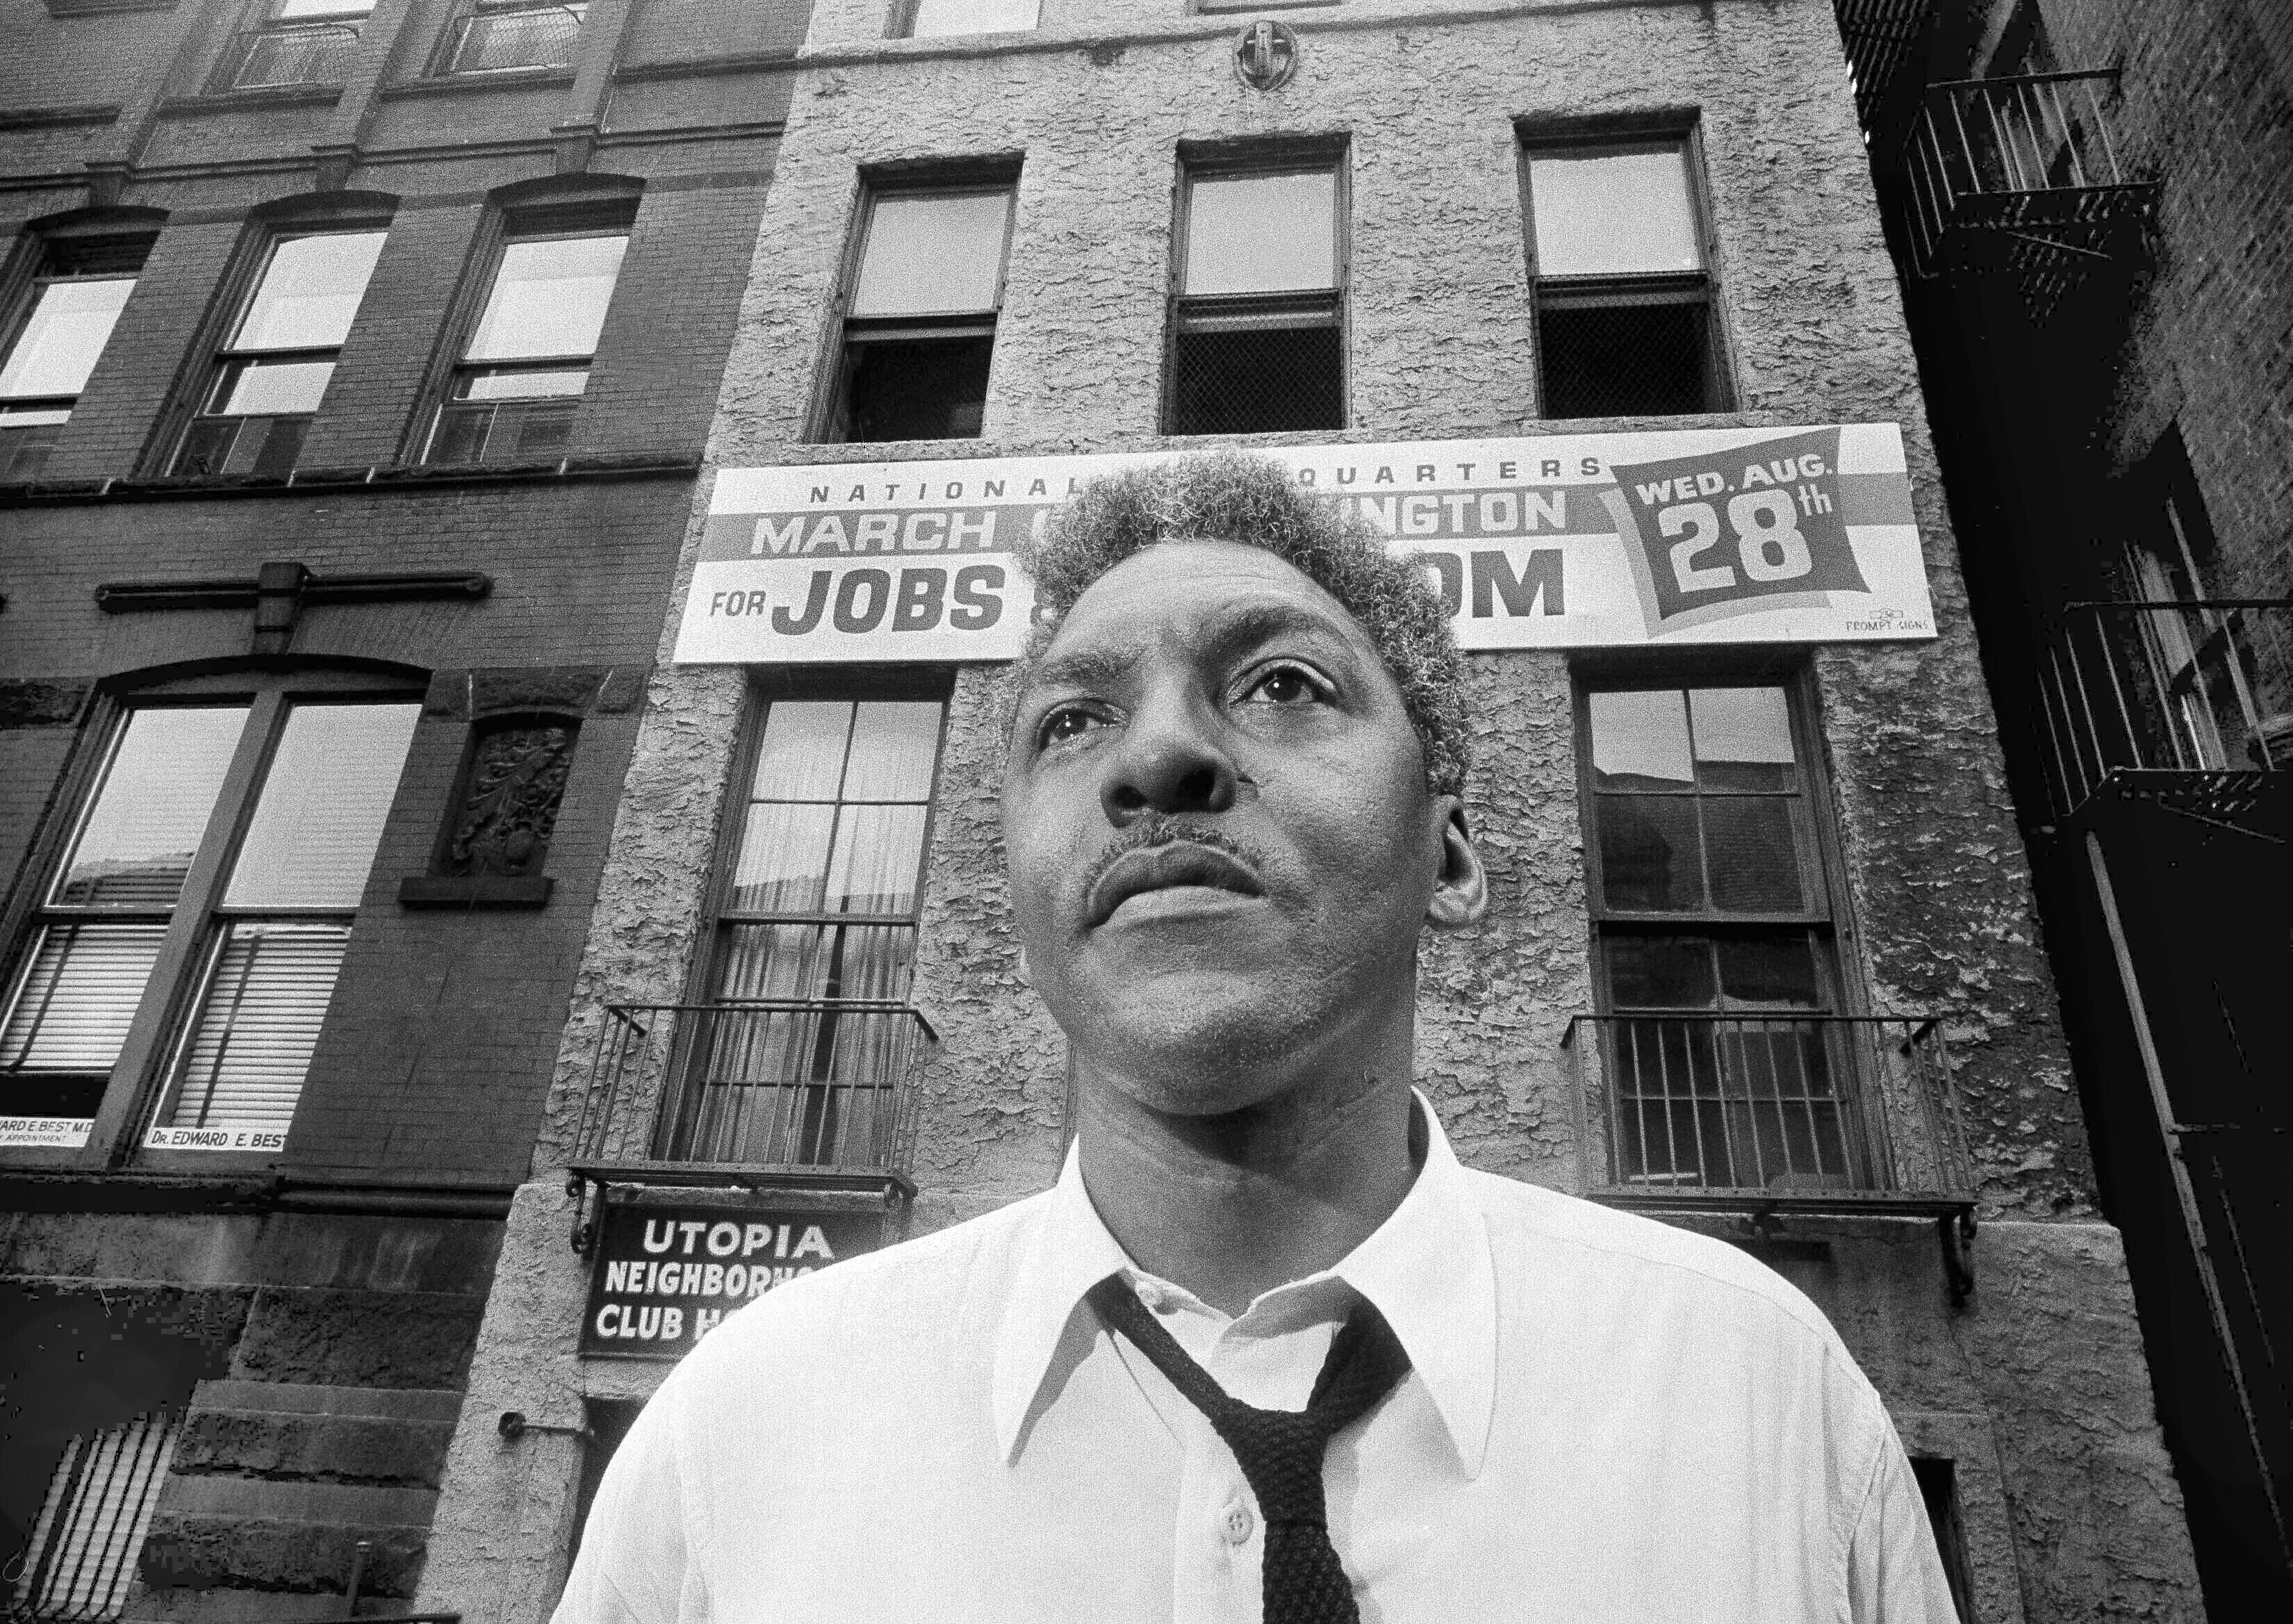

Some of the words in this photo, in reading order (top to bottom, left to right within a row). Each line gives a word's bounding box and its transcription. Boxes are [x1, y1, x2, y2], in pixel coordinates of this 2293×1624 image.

[809, 477, 1083, 503] NATIONAL
[1297, 457, 1600, 487] QUARTERS
[1635, 471, 1735, 506] WED.
[1742, 453, 1833, 489] AUG.
[750, 510, 996, 555] MARCH
[1338, 490, 1567, 534] INGTON
[1658, 484, 1833, 593] 28th
[709, 589, 766, 617] FOR
[771, 564, 1005, 635] JOBS
[38, 1121, 72, 1133] BEST
[171, 1131, 228, 1147] EDWARD
[643, 1219, 835, 1259] UTOPIA
[595, 1304, 684, 1340] CLUB
